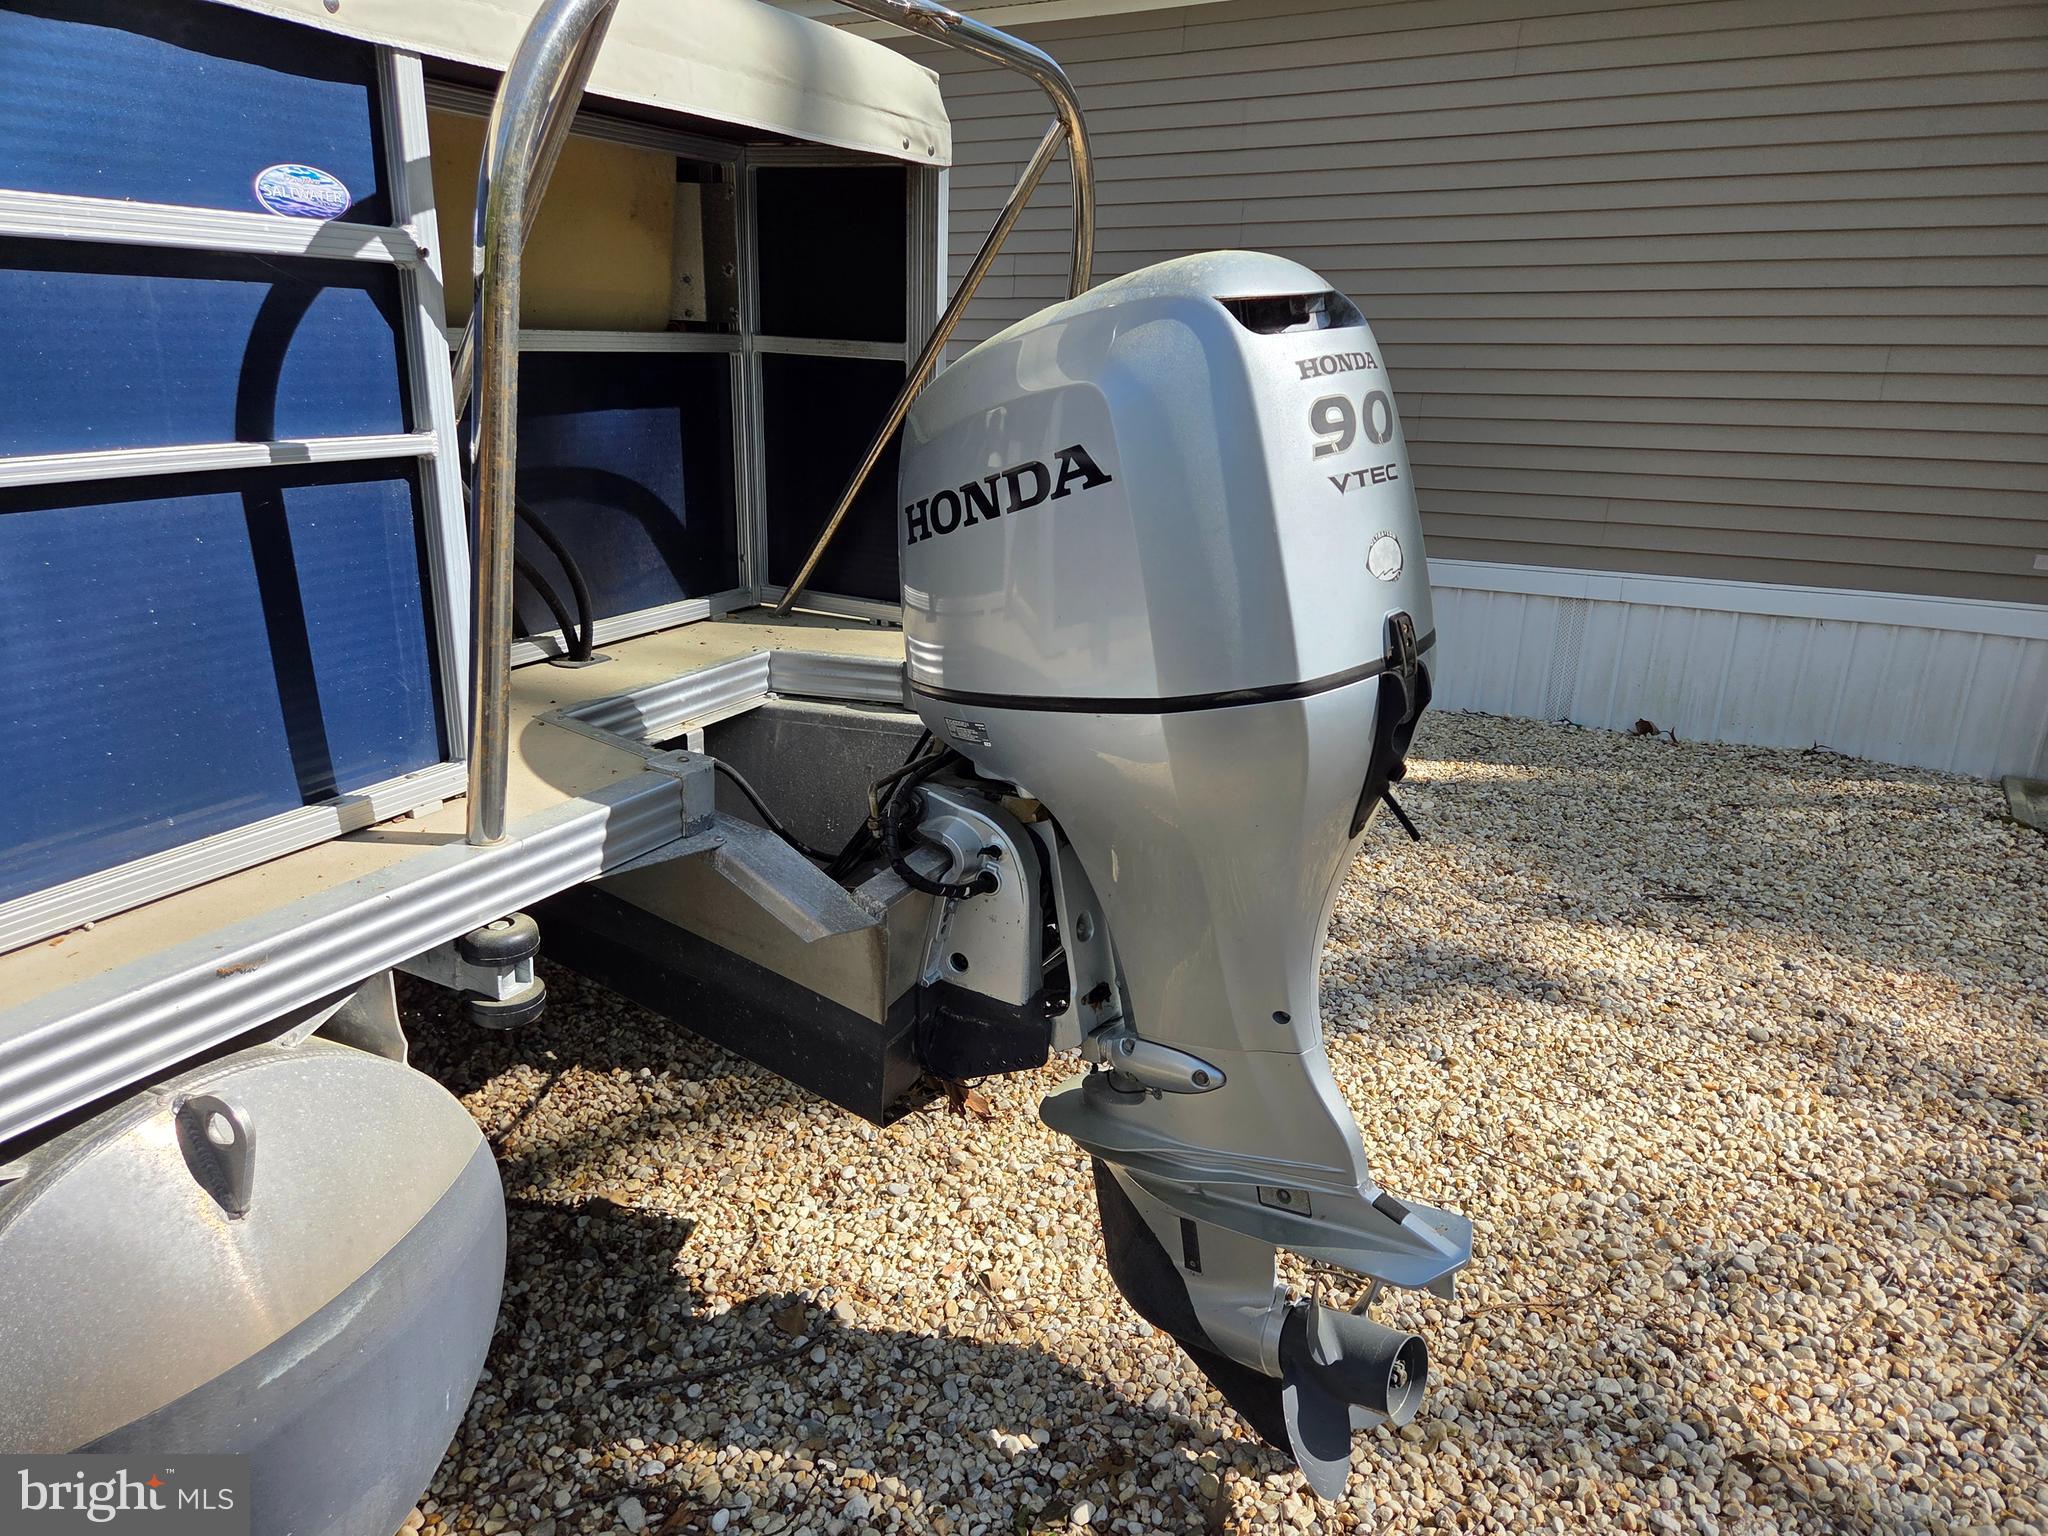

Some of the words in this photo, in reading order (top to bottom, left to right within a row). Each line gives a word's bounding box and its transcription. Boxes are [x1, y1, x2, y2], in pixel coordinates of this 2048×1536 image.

[263, 184, 342, 204] SALTWATER
[1295, 352, 1378, 380] HONDA
[1309, 390, 1393, 461] 90
[1328, 463, 1398, 494] VTEC
[905, 444, 1112, 545] HONDA
